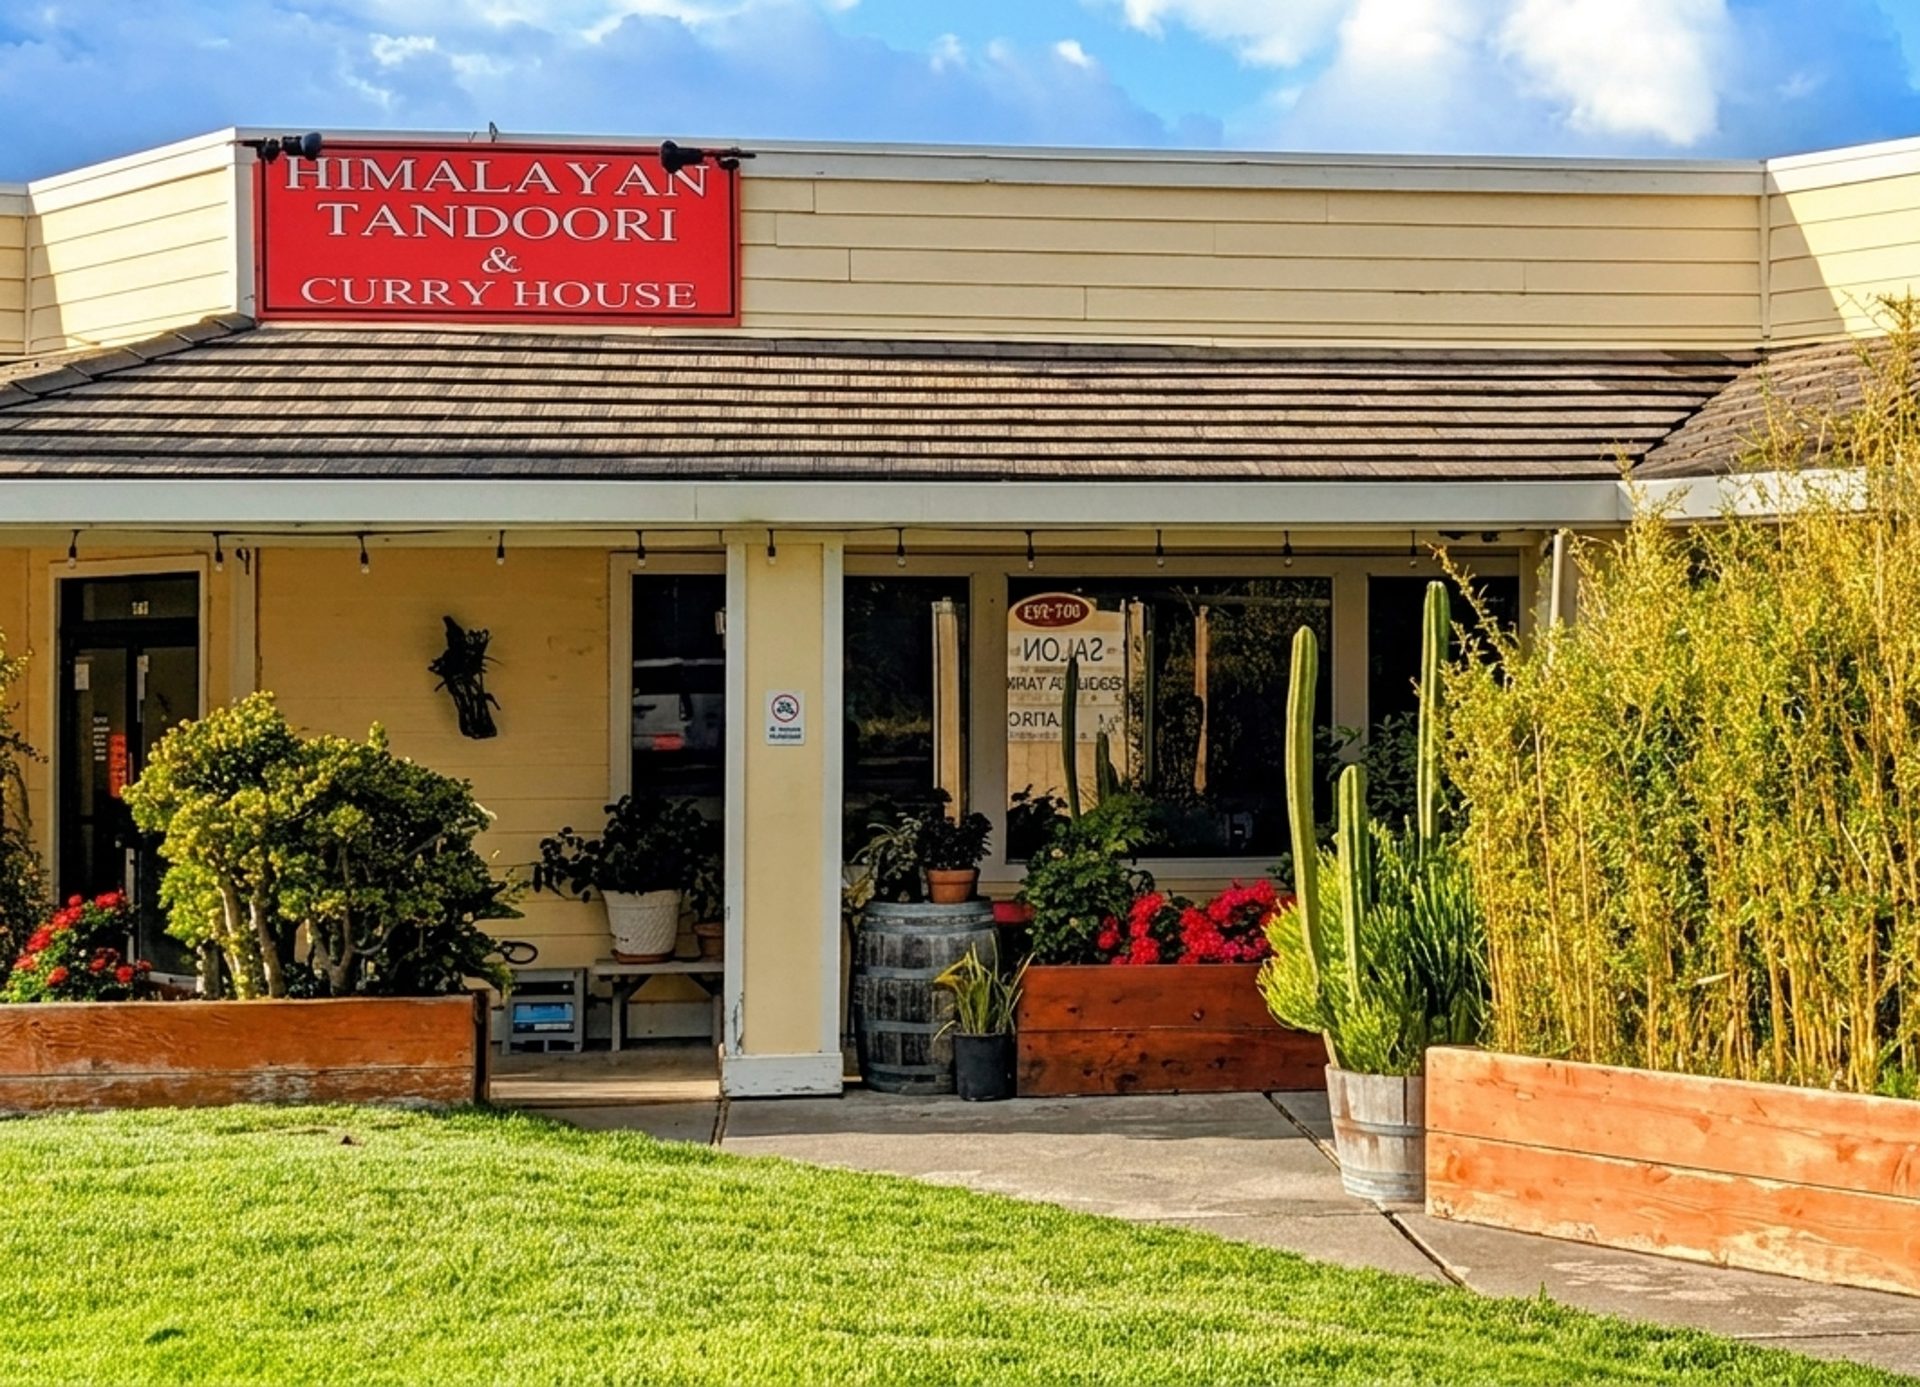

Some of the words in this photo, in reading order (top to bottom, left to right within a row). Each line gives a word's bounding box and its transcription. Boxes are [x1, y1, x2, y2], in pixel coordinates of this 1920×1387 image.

[284, 155, 710, 197] HIMALAYAN
[317, 203, 678, 242] TANDOORI
[481, 246, 522, 274] &
[300, 277, 496, 307] CURRY
[513, 280, 698, 309] HOUSE
